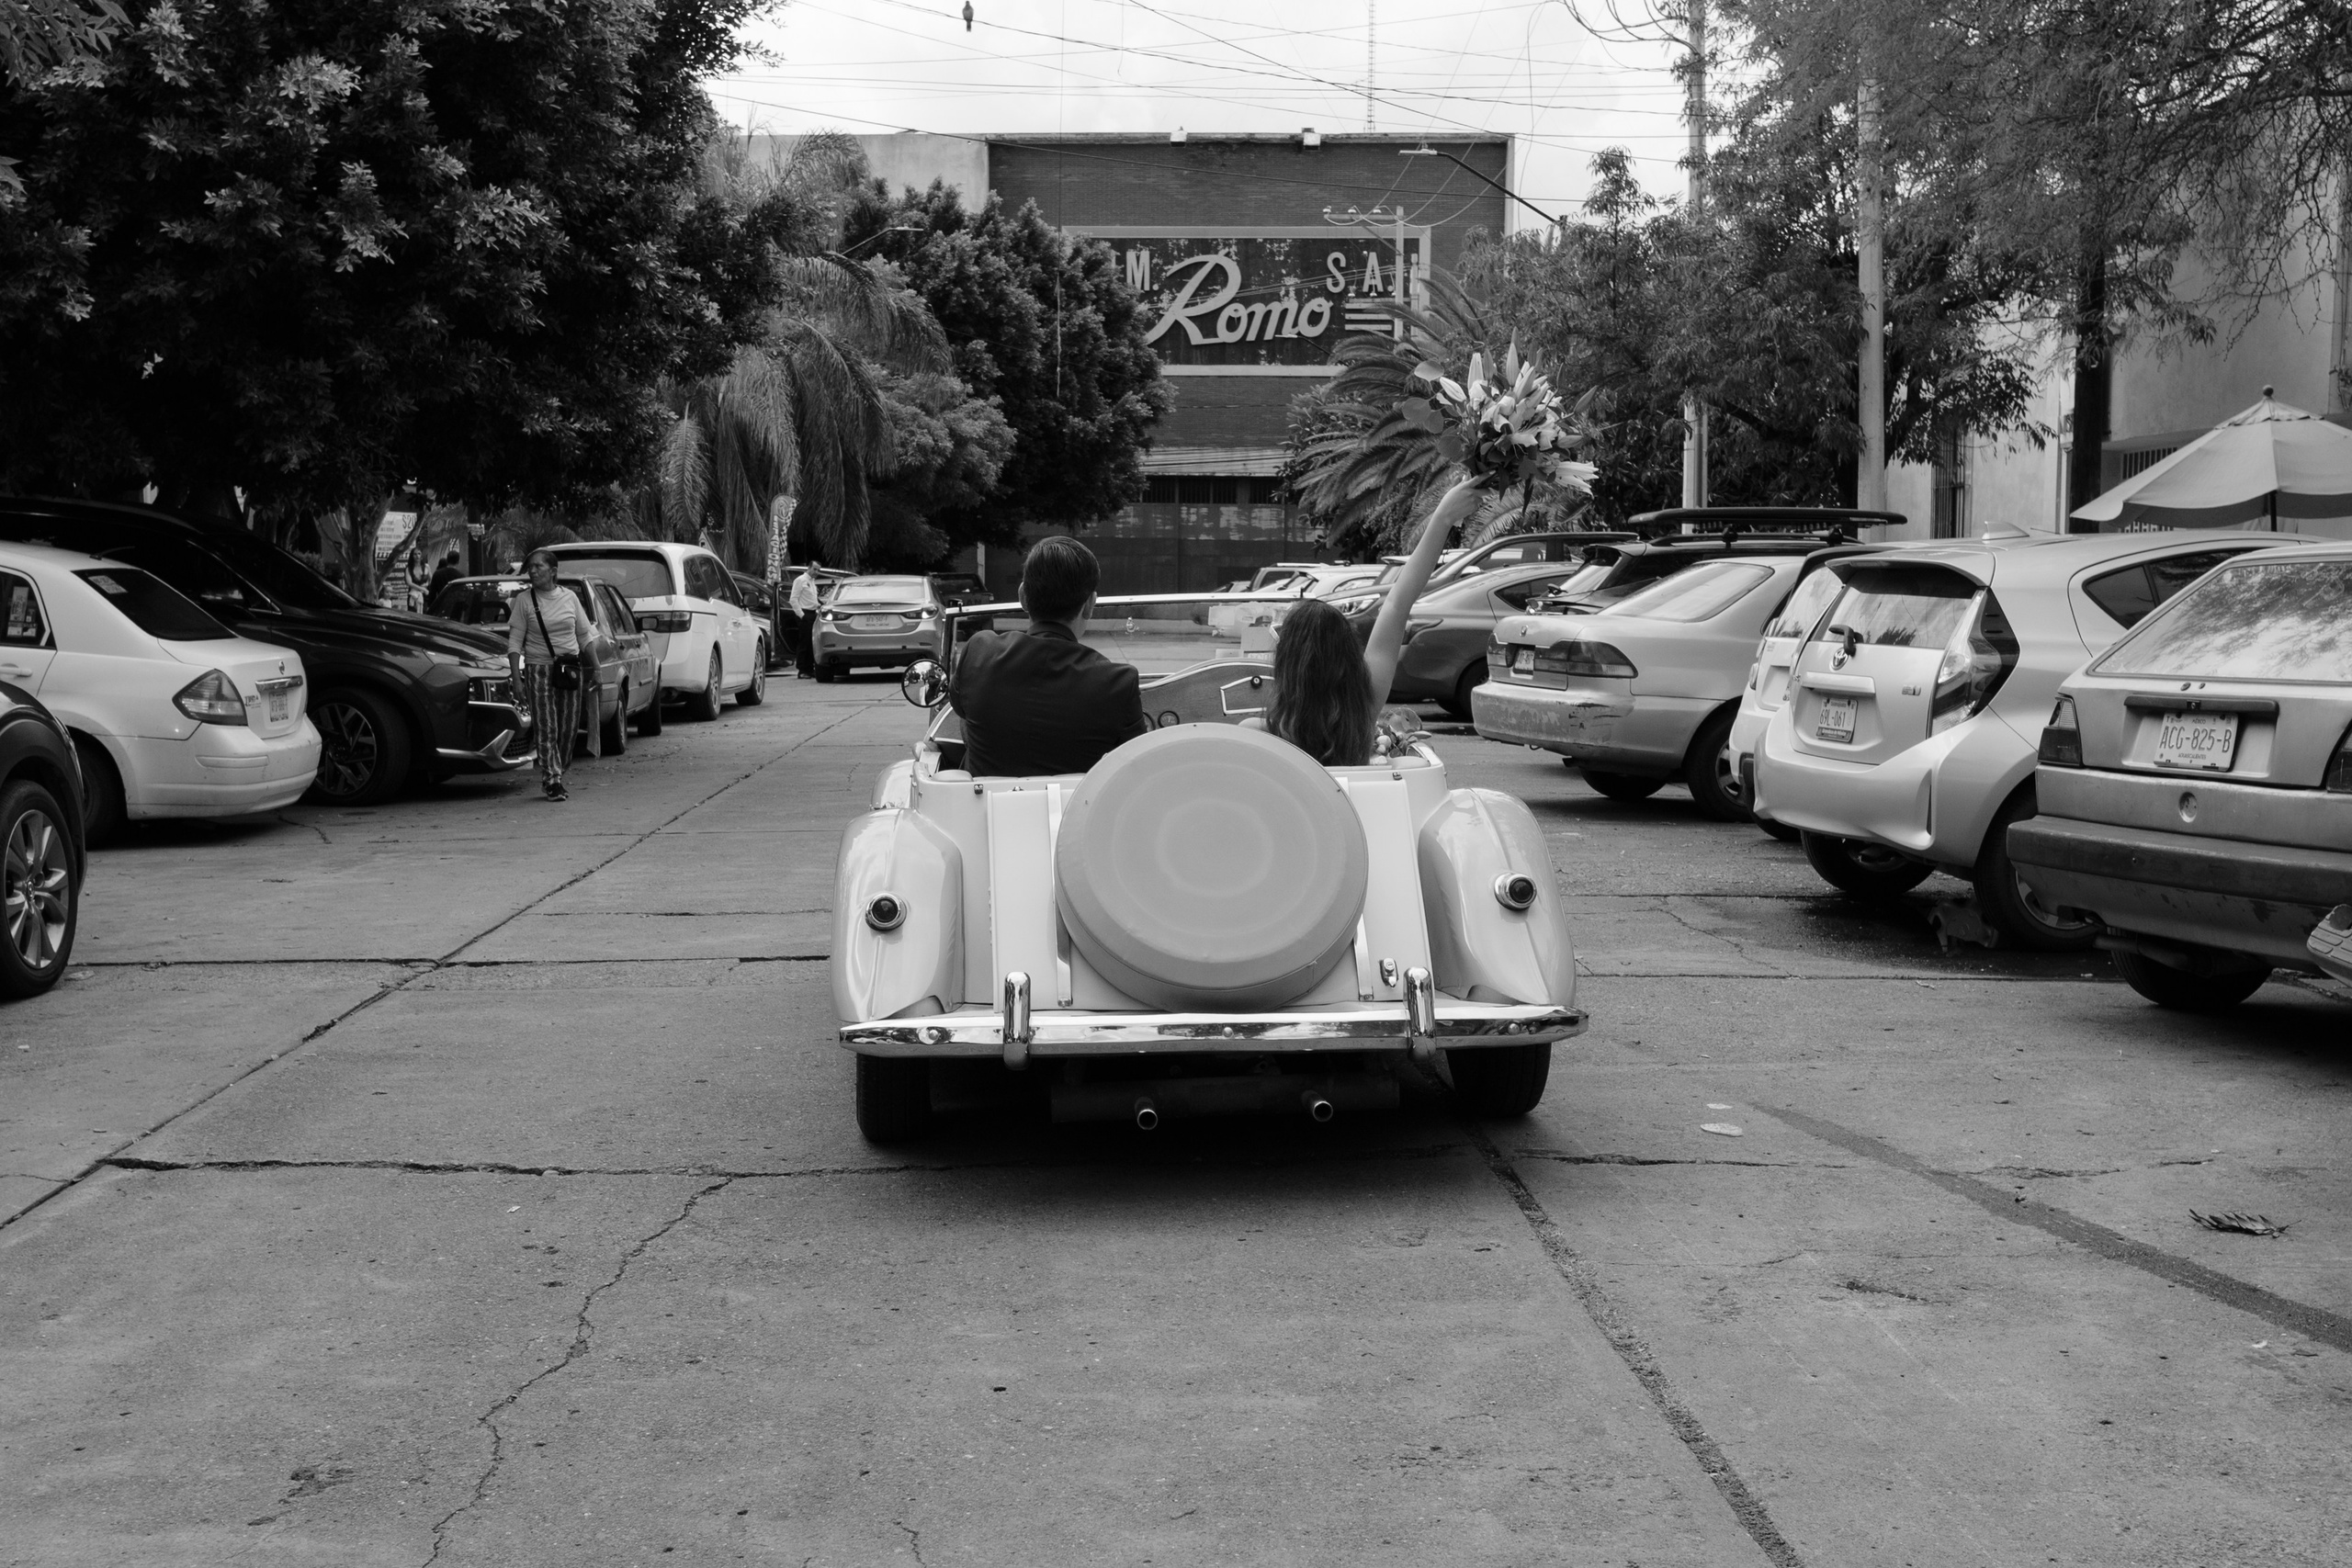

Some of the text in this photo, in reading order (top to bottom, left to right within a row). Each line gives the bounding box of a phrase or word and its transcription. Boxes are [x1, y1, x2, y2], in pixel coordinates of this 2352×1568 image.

[1125, 249, 1159, 291] M.
[1146, 248, 1333, 345] Romo
[2159, 725, 2233, 753] ACG-825-B
